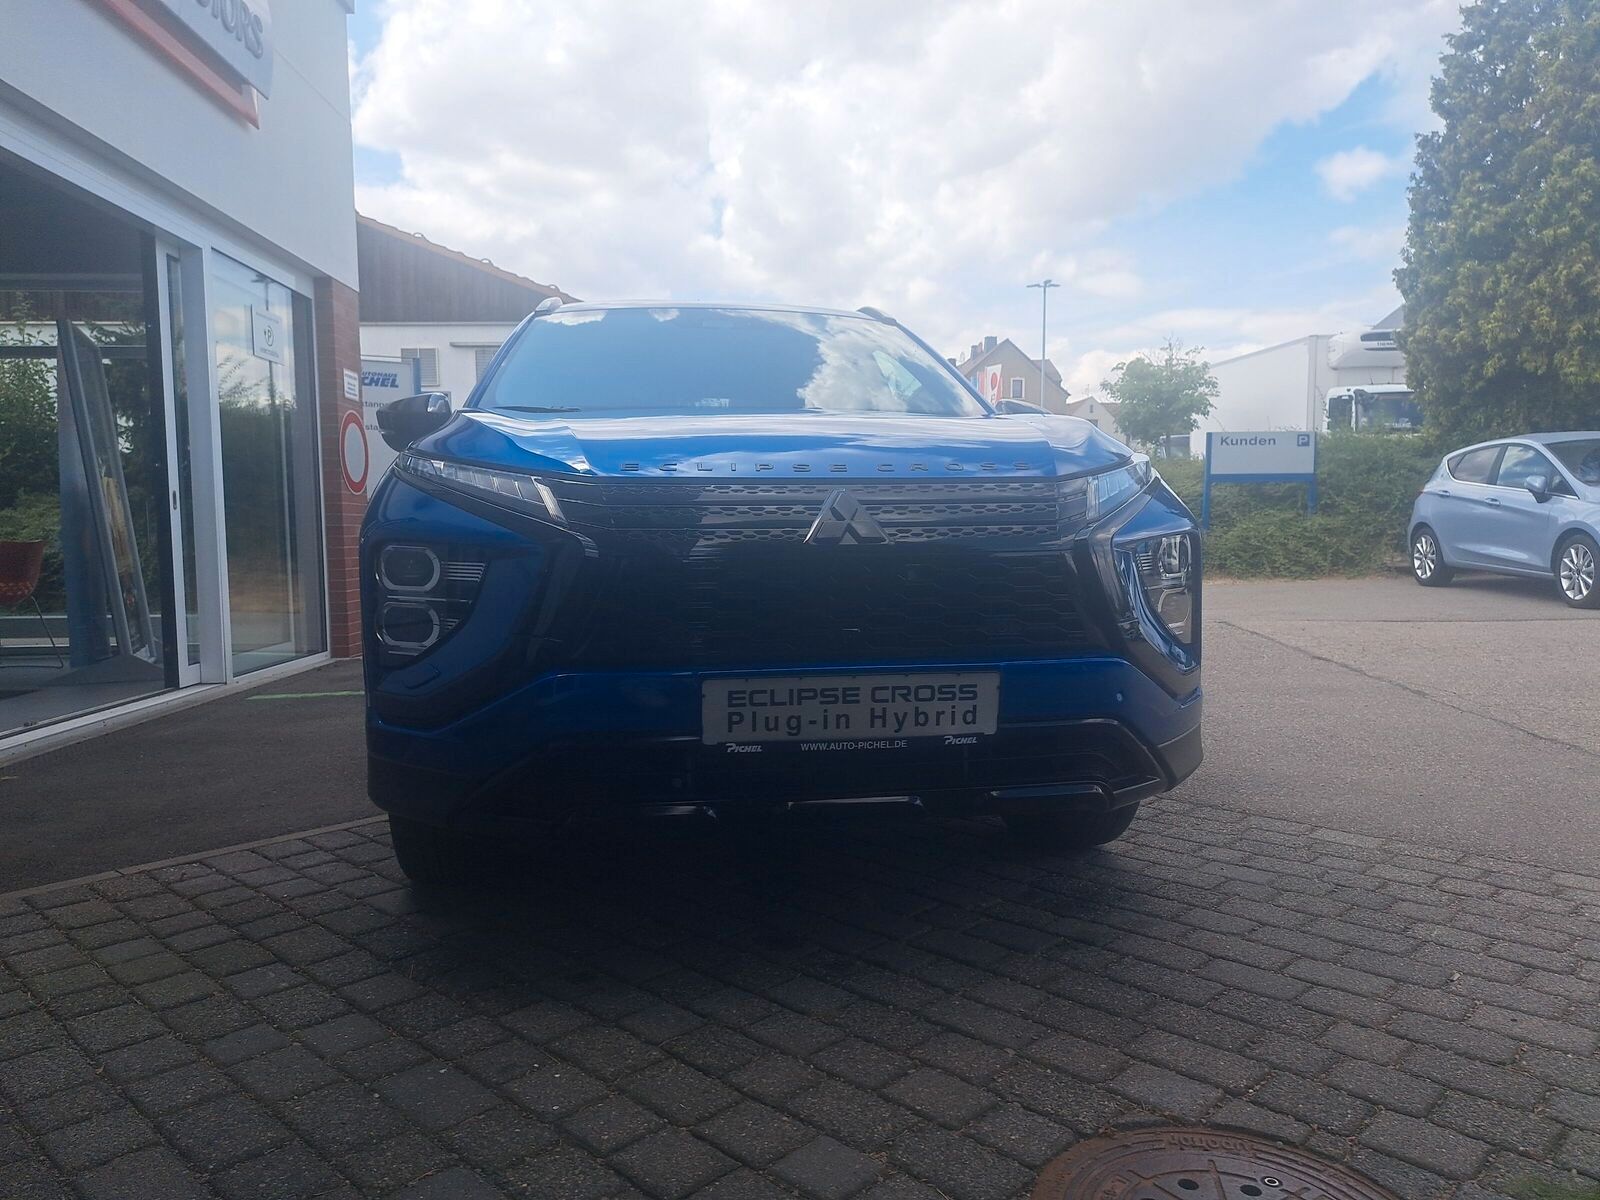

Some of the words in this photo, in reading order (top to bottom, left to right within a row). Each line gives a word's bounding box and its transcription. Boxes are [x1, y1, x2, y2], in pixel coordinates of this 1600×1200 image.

[1220, 436, 1277, 446] Kunden
[619, 462, 848, 473] ECLIPSE
[876, 461, 1030, 472] CROSS
[727, 687, 861, 708] ECLIPSE
[870, 683, 978, 704] CROSS
[727, 709, 850, 736] Plug-in
[870, 705, 977, 733] Hybrid
[800, 740, 908, 752] WWW.AUTO-PICHEL.DE
